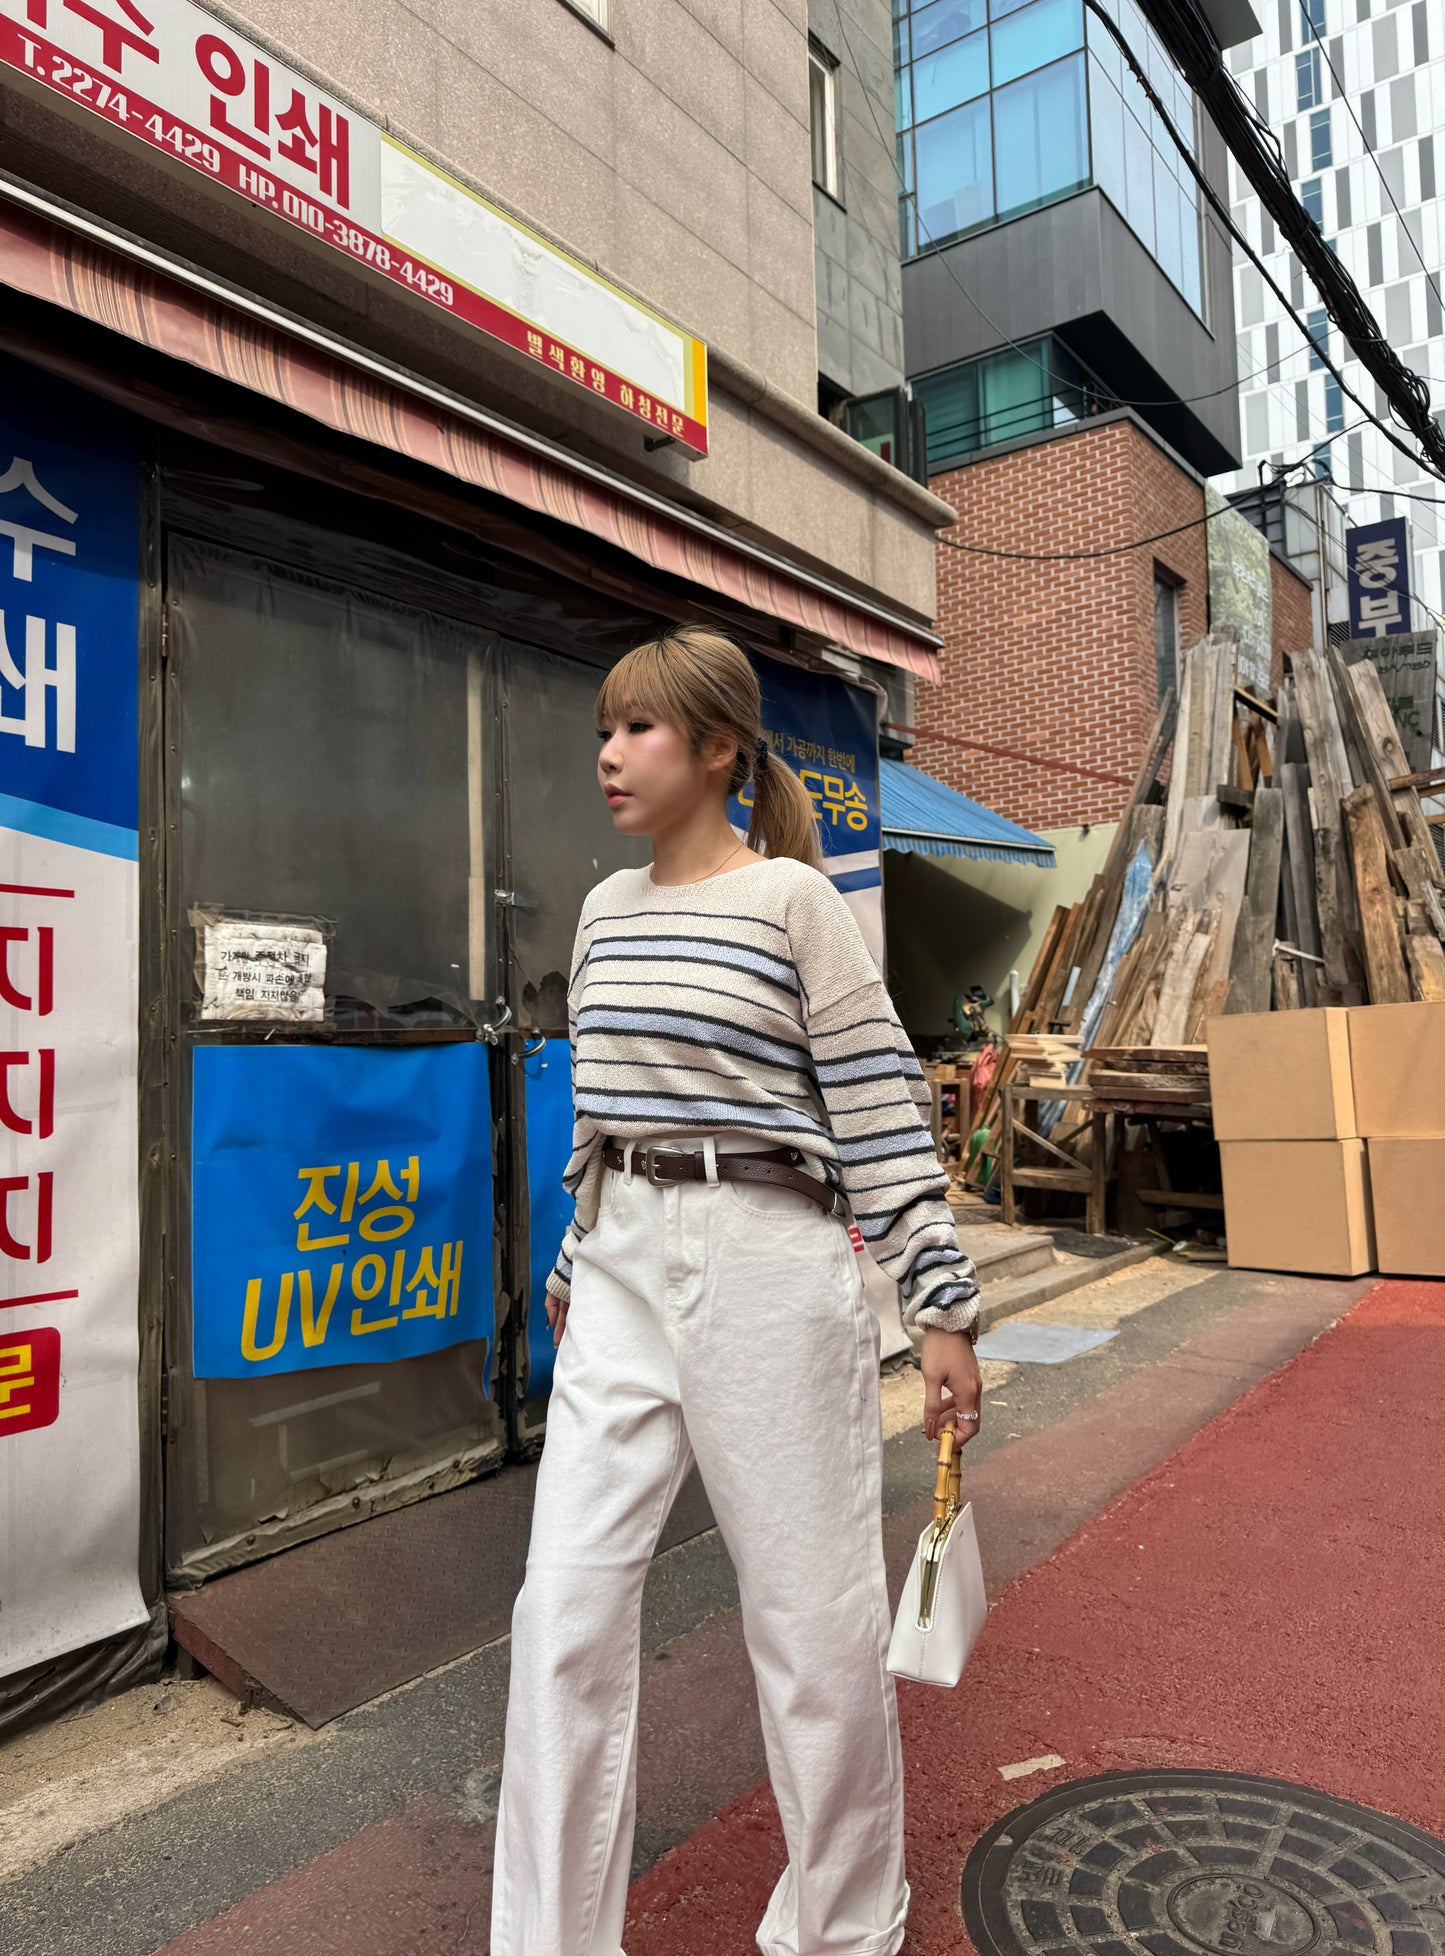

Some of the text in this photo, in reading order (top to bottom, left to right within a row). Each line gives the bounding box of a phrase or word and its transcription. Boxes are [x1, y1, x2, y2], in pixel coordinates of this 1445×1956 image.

[194, 33, 350, 211] 인쇄
[787, 736, 825, 766] 가공까지
[827, 747, 856, 773] 한번에
[232, 970, 262, 983] 개방시
[293, 1155, 421, 1252] 진성
